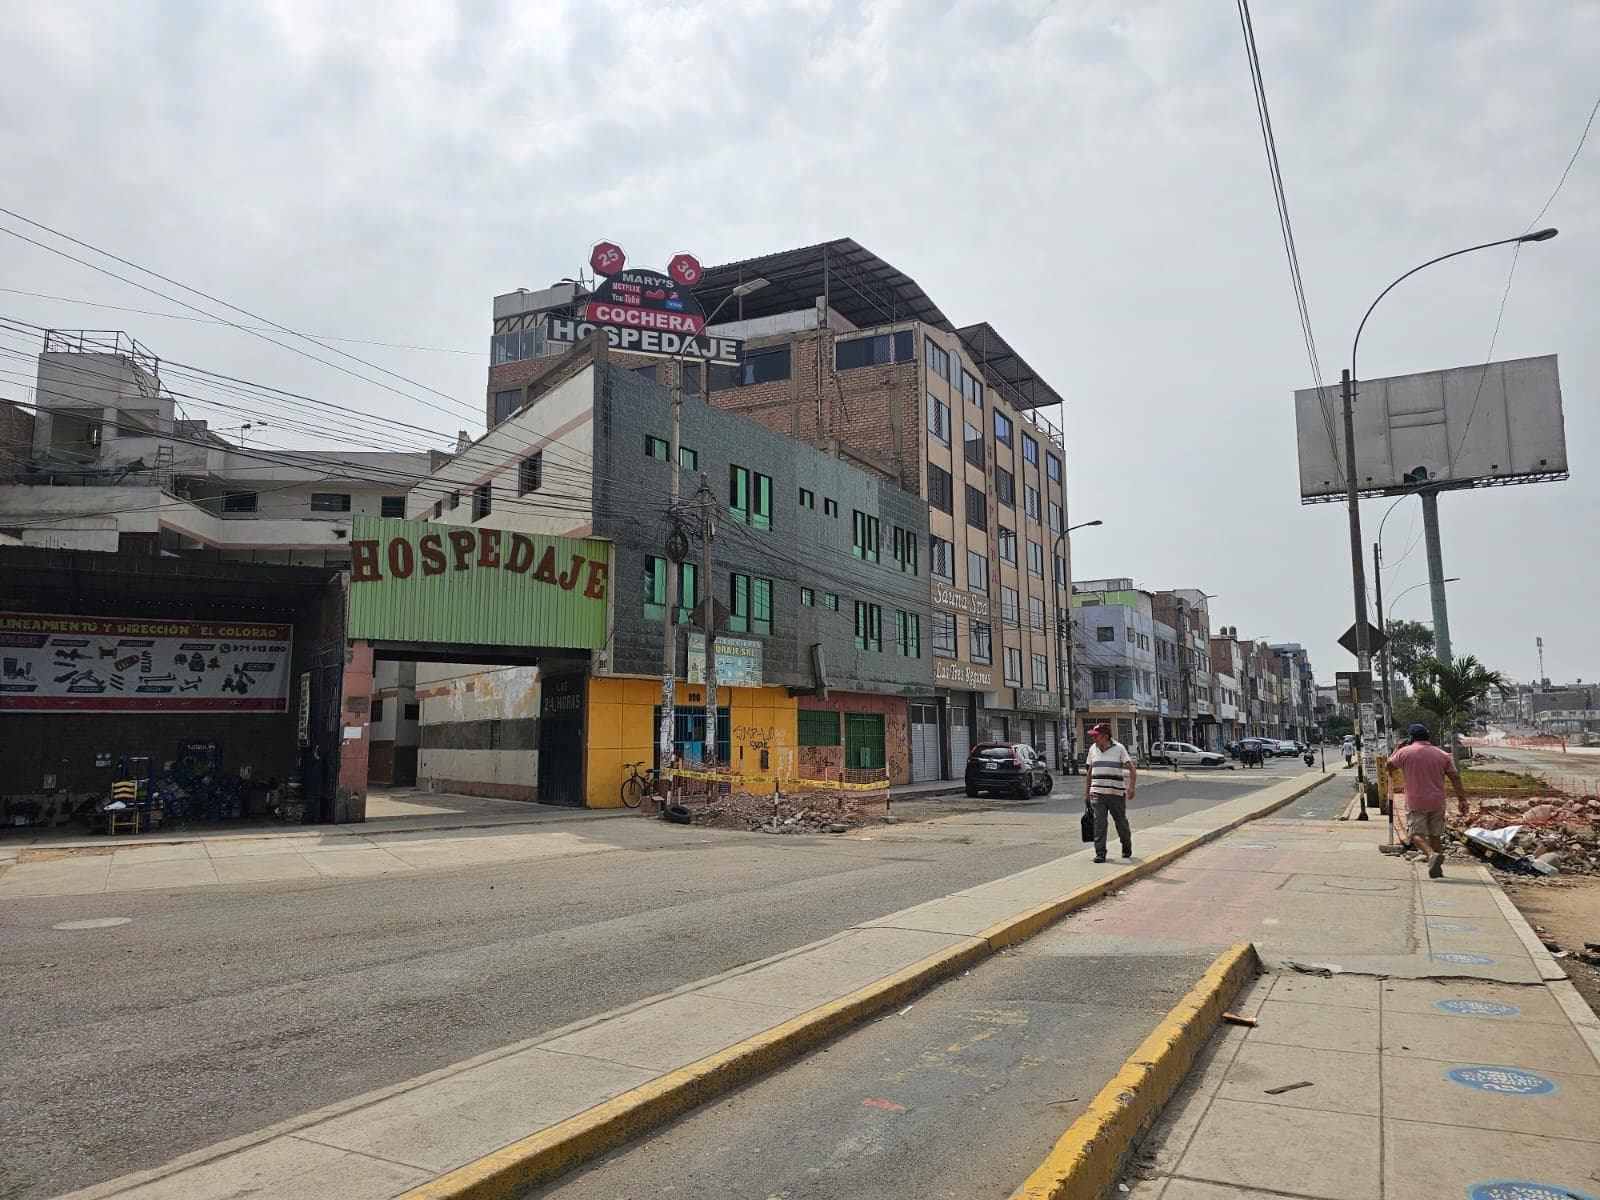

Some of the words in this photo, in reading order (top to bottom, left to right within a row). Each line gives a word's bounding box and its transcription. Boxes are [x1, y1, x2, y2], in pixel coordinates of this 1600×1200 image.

[597, 249, 619, 267] 25
[622, 273, 674, 289] MARY'S
[676, 260, 696, 281] 30
[612, 282, 641, 294] NETFLIX
[596, 305, 697, 332] COCHERA
[553, 319, 738, 361] HOSPEDAJE
[349, 527, 609, 600] HOSPEDAJE
[934, 582, 967, 610] Sauna
[970, 594, 988, 617] Spa
[103, 623, 111, 633] Y
[117, 623, 189, 637] DIRECCIÓN
[936, 662, 950, 679] Las
[966, 667, 991, 688] Regiones
